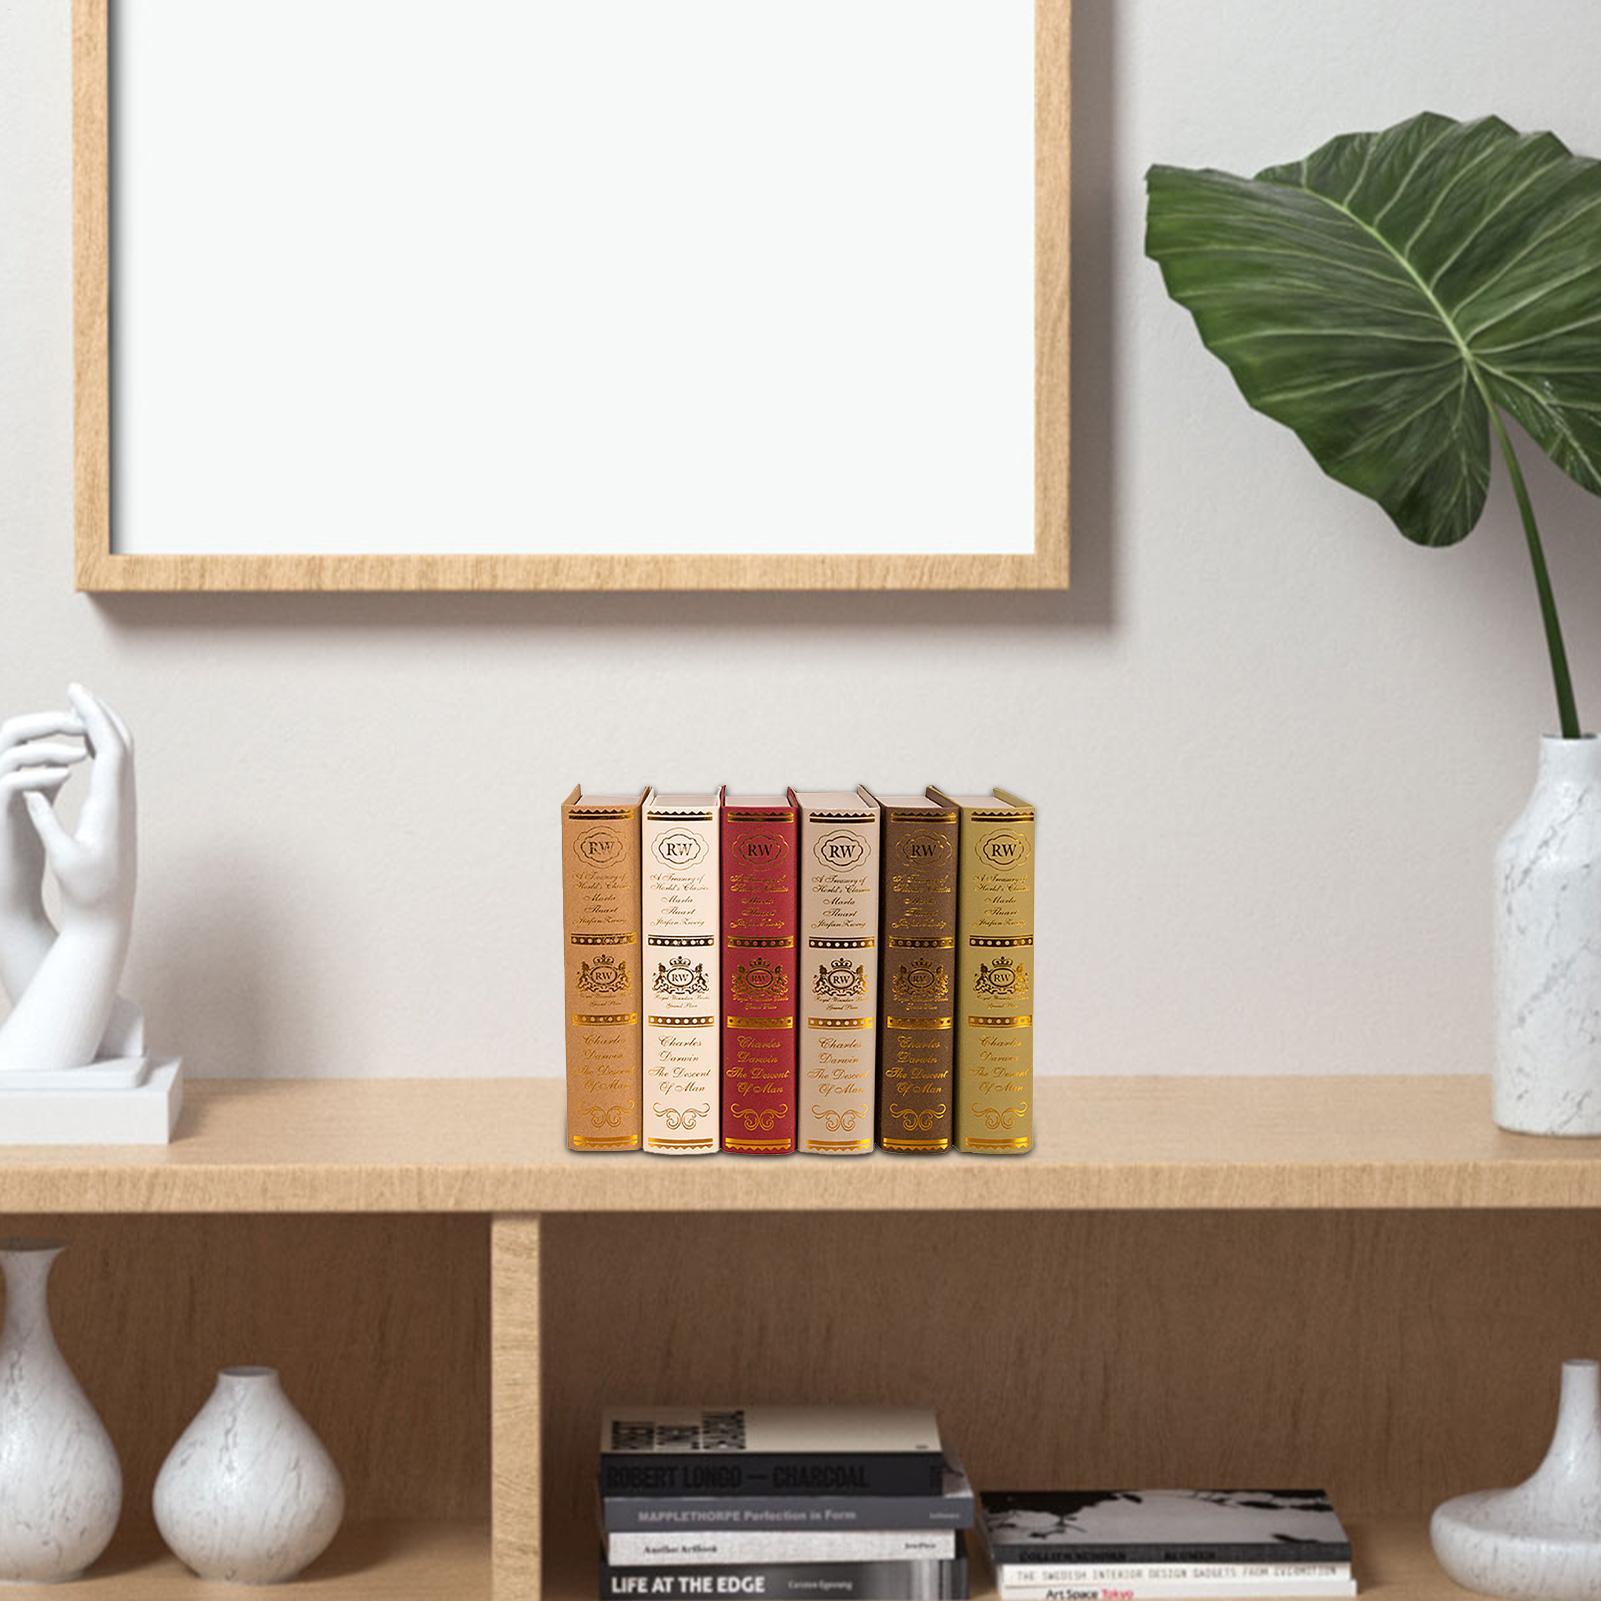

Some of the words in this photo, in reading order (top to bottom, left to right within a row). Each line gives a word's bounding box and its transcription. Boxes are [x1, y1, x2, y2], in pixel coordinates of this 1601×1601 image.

[588, 841, 614, 854] RW
[666, 844, 691, 856] RW
[747, 844, 772, 856] RW
[829, 845, 855, 858] RW
[911, 845, 936, 857] RW
[992, 845, 1018, 857] RW
[595, 972, 612, 980] RW
[672, 973, 689, 982] RW
[658, 1036, 702, 1047] Charles
[737, 1037, 781, 1048] Charles
[660, 1050, 699, 1061] Darwin
[737, 1053, 778, 1062] Darwin
[819, 1053, 858, 1063] Darwin
[649, 1067, 669, 1077] The
[672, 1067, 710, 1077] Descent
[726, 1067, 748, 1078] The
[808, 1068, 829, 1079] The
[885, 1067, 908, 1079] The
[659, 1080, 673, 1094] Of
[674, 1081, 705, 1092] Man
[737, 1081, 751, 1095] Of
[752, 1082, 784, 1093] Man
[818, 1082, 832, 1096] Of
[835, 1082, 864, 1093] Man
[896, 1082, 910, 1096] Of
[914, 1082, 942, 1093] Man
[979, 1082, 992, 1095] Of
[996, 1082, 1023, 1092] Man
[607, 1466, 678, 1489] ROBERT
[682, 1465, 742, 1487] LONGO
[773, 1463, 870, 1487] CHARCOAL
[638, 1510, 741, 1522] MAPPLETHORPE
[743, 1510, 806, 1521] Perfection
[810, 1510, 821, 1521] in
[825, 1509, 857, 1520] Form
[1017, 1571, 1035, 1580] THE
[1042, 1570, 1087, 1580] SWEDISH
[1092, 1569, 1143, 1580] INTERIOR
[1149, 1568, 1187, 1578] DESIGN
[1193, 1567, 1237, 1578] GADGETS
[1243, 1566, 1268, 1577] FROM
[612, 1578, 648, 1593] LIFE
[652, 1577, 674, 1593] AT
[678, 1577, 714, 1593] THE
[717, 1577, 765, 1593] EDGE
[1046, 1588, 1064, 1599] Art
[1065, 1588, 1098, 1601] Space
[1101, 1588, 1134, 1601] Tokyo
